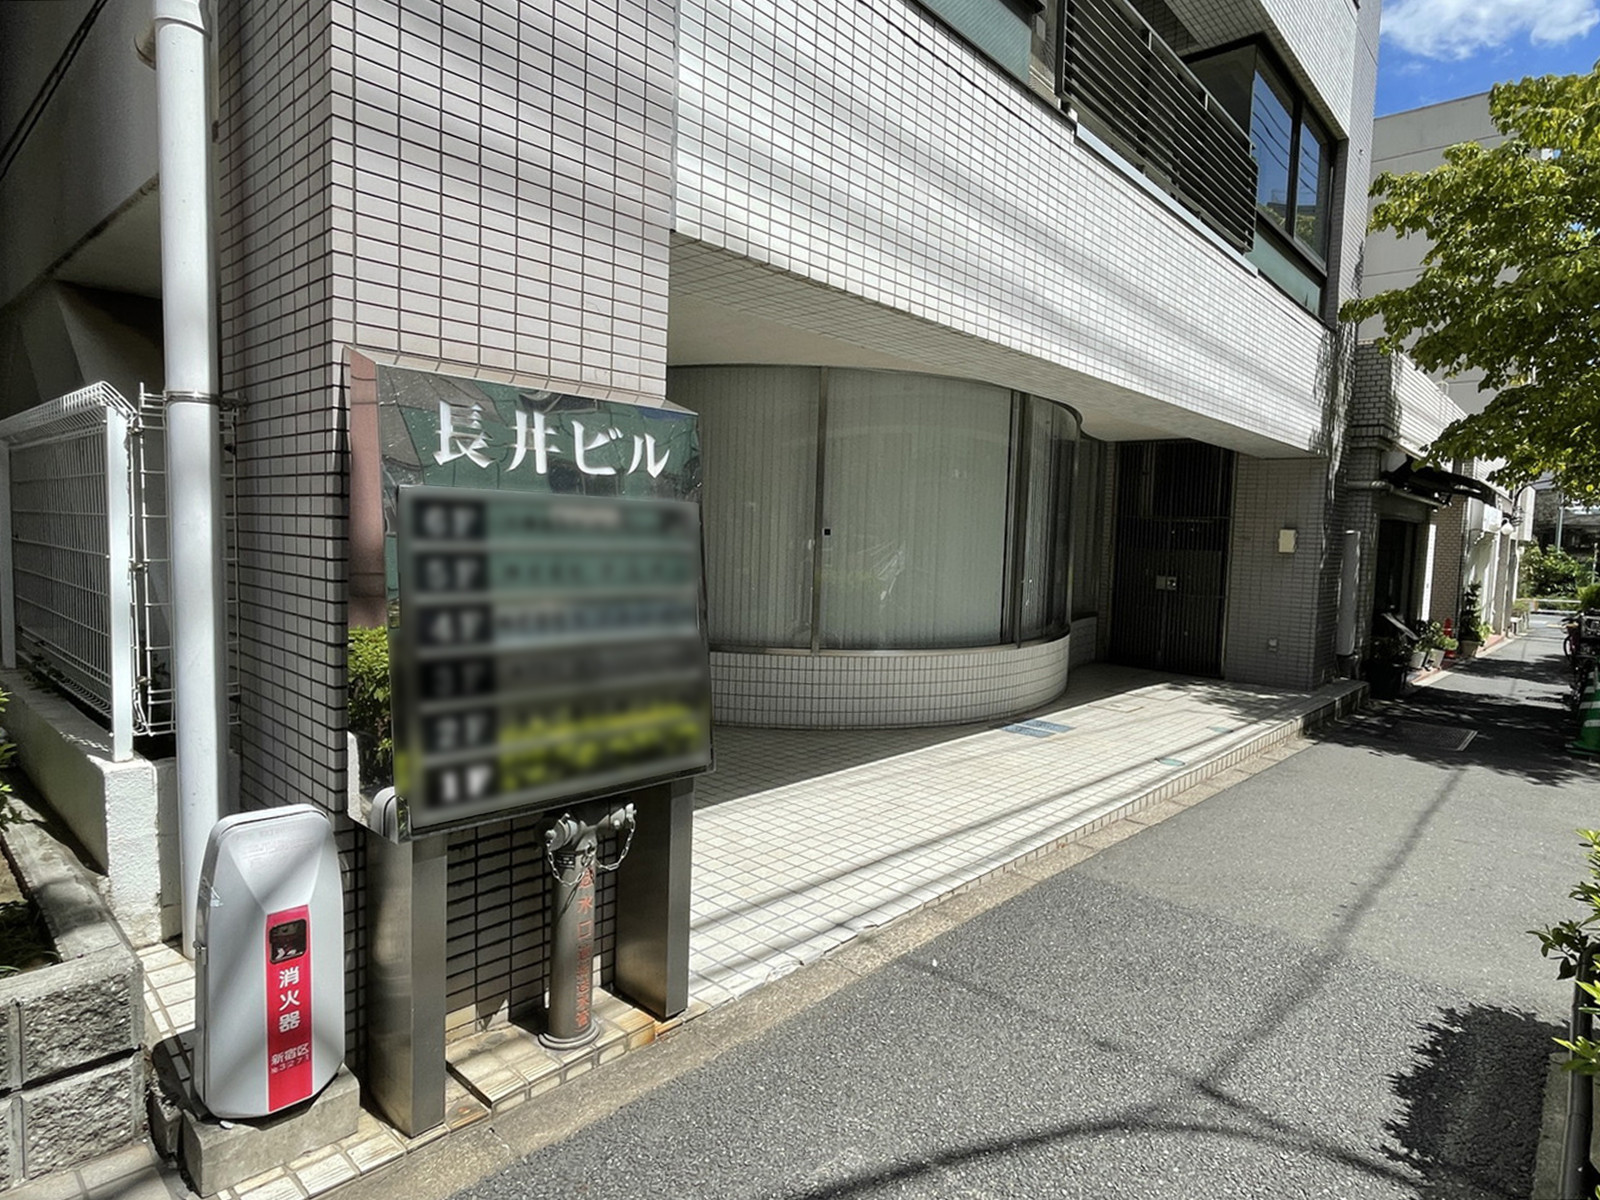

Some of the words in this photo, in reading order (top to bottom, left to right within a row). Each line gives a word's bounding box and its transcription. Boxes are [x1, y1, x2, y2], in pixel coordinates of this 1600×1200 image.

[433, 400, 671, 479] 長井ビル
[279, 965, 301, 1034] 消火器
[271, 1042, 310, 1066] 新宿区
